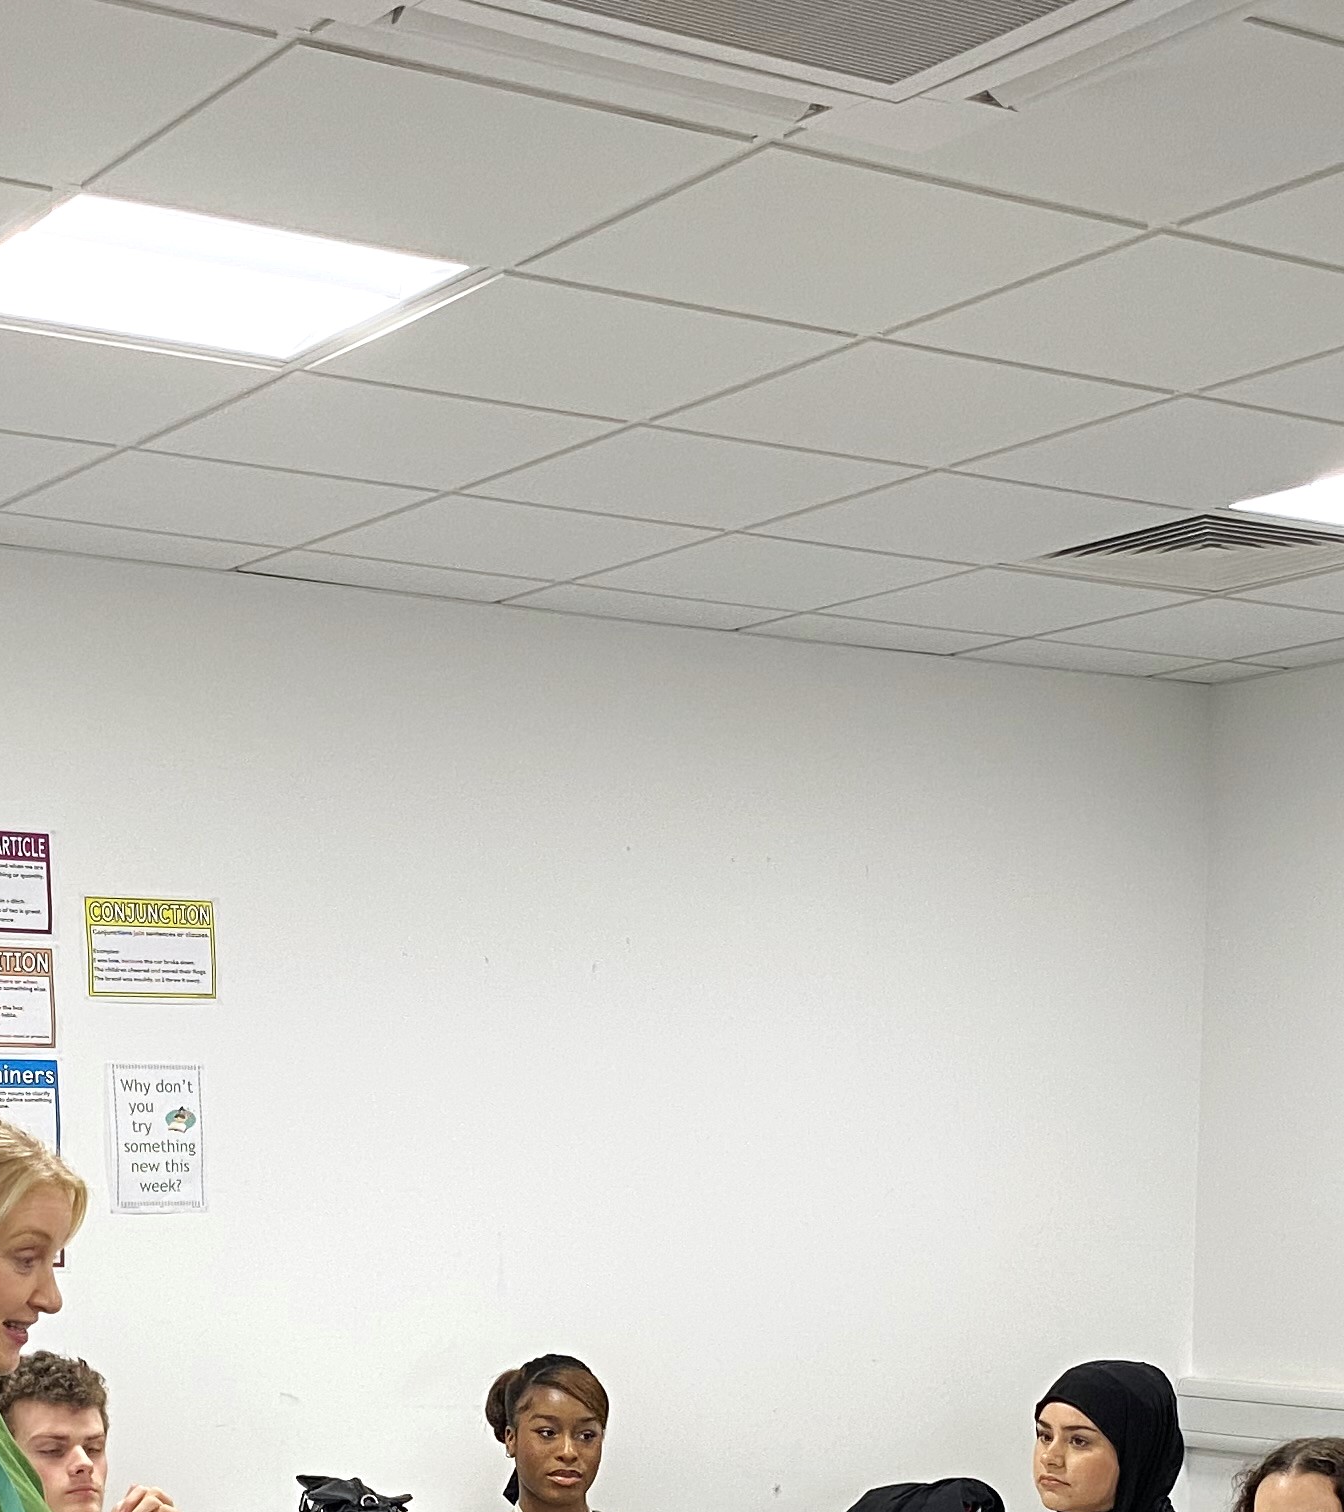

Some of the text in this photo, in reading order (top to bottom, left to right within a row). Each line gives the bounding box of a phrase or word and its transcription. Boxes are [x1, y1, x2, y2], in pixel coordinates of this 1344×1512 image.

[90, 902, 210, 925] CONJUNCTION
[120, 1079, 193, 1096] Why don't
[129, 1102, 153, 1115] you
[132, 1121, 152, 1136] try
[124, 1139, 196, 1156] something
[131, 1159, 190, 1172] new this
[140, 1179, 182, 1192] week?
